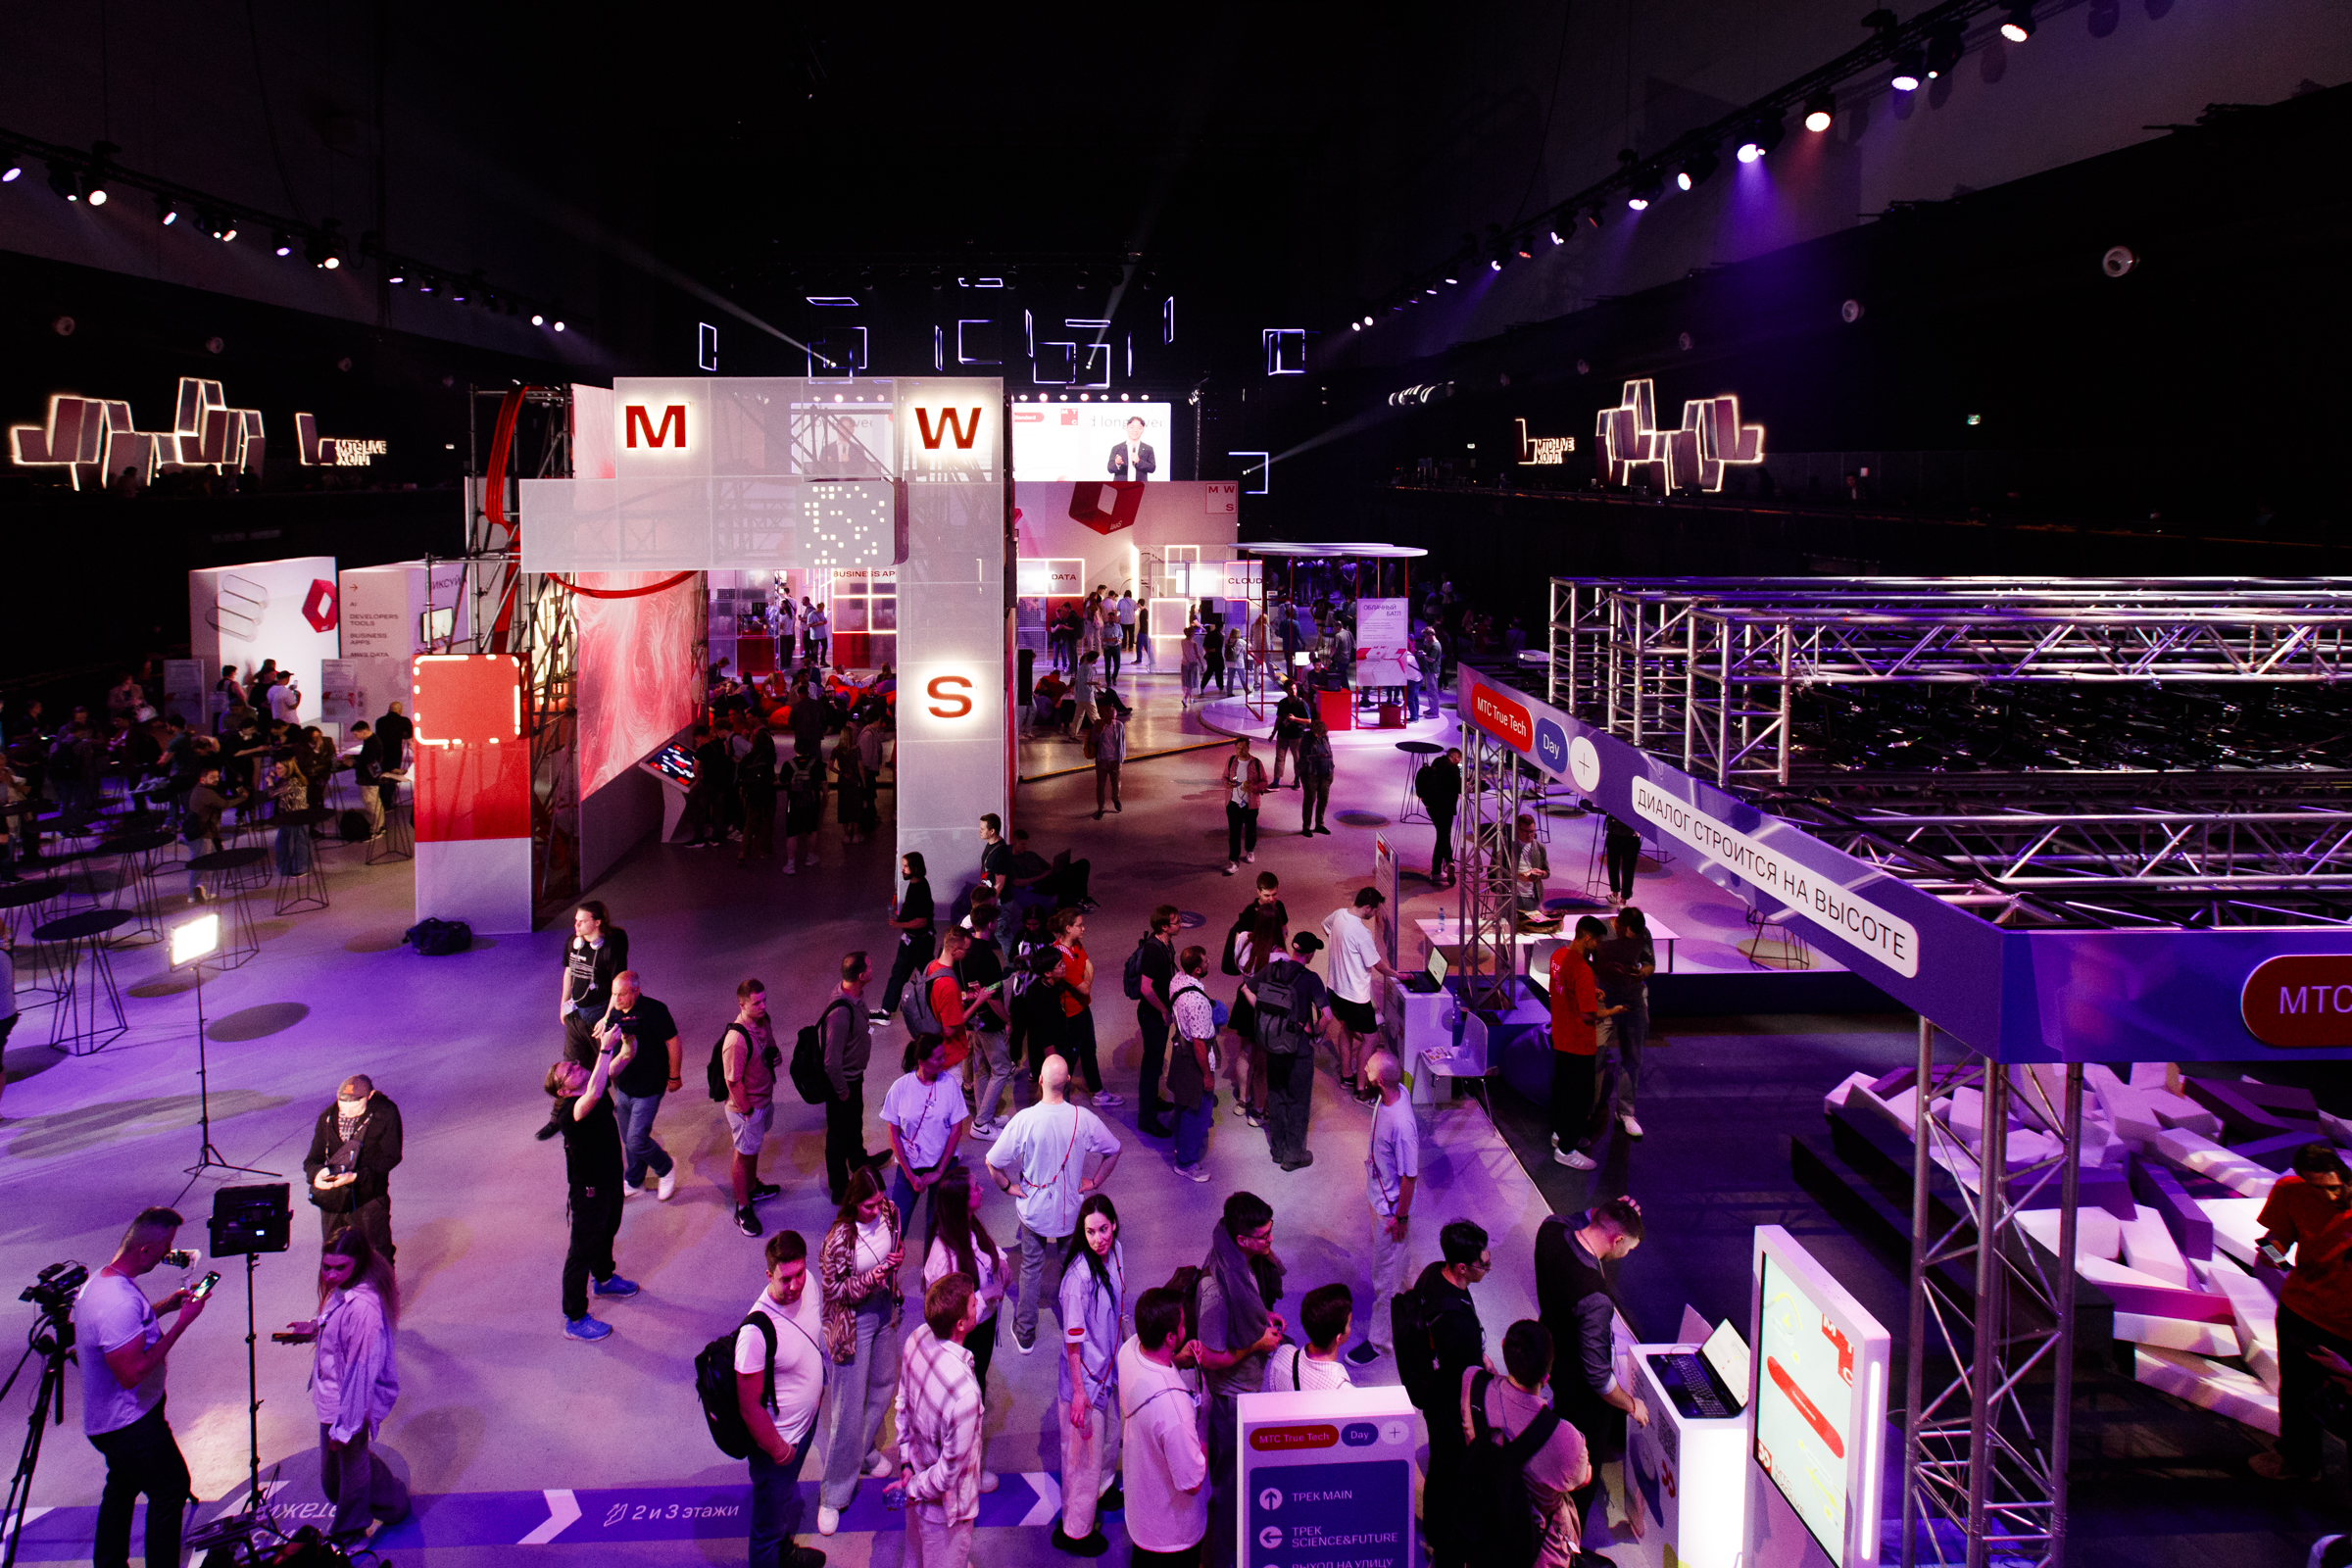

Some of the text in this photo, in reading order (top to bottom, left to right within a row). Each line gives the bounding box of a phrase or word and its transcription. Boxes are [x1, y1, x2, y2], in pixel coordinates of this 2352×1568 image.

[625, 405, 982, 449] M W
[926, 675, 973, 718] S
[1493, 705, 1508, 726] True
[1509, 713, 1527, 737] Tech
[1543, 733, 1560, 760] Day
[1638, 788, 1906, 960] ДИАЛОГ СТРОИТСЯ НА ВЫСОТЕ
[1283, 1434, 1304, 1443] True
[1307, 1432, 1330, 1442] Tech
[1350, 1430, 1369, 1441] Day
[1292, 1490, 1353, 1502] ТРЕК MAIN
[631, 1504, 740, 1520] 2 и 3 этажи
[1292, 1526, 1322, 1537] ТРЕК
[1292, 1532, 1398, 1548] SCIENCE&FUTURE
[1354, 1558, 1394, 1568] УЛИЦУ
